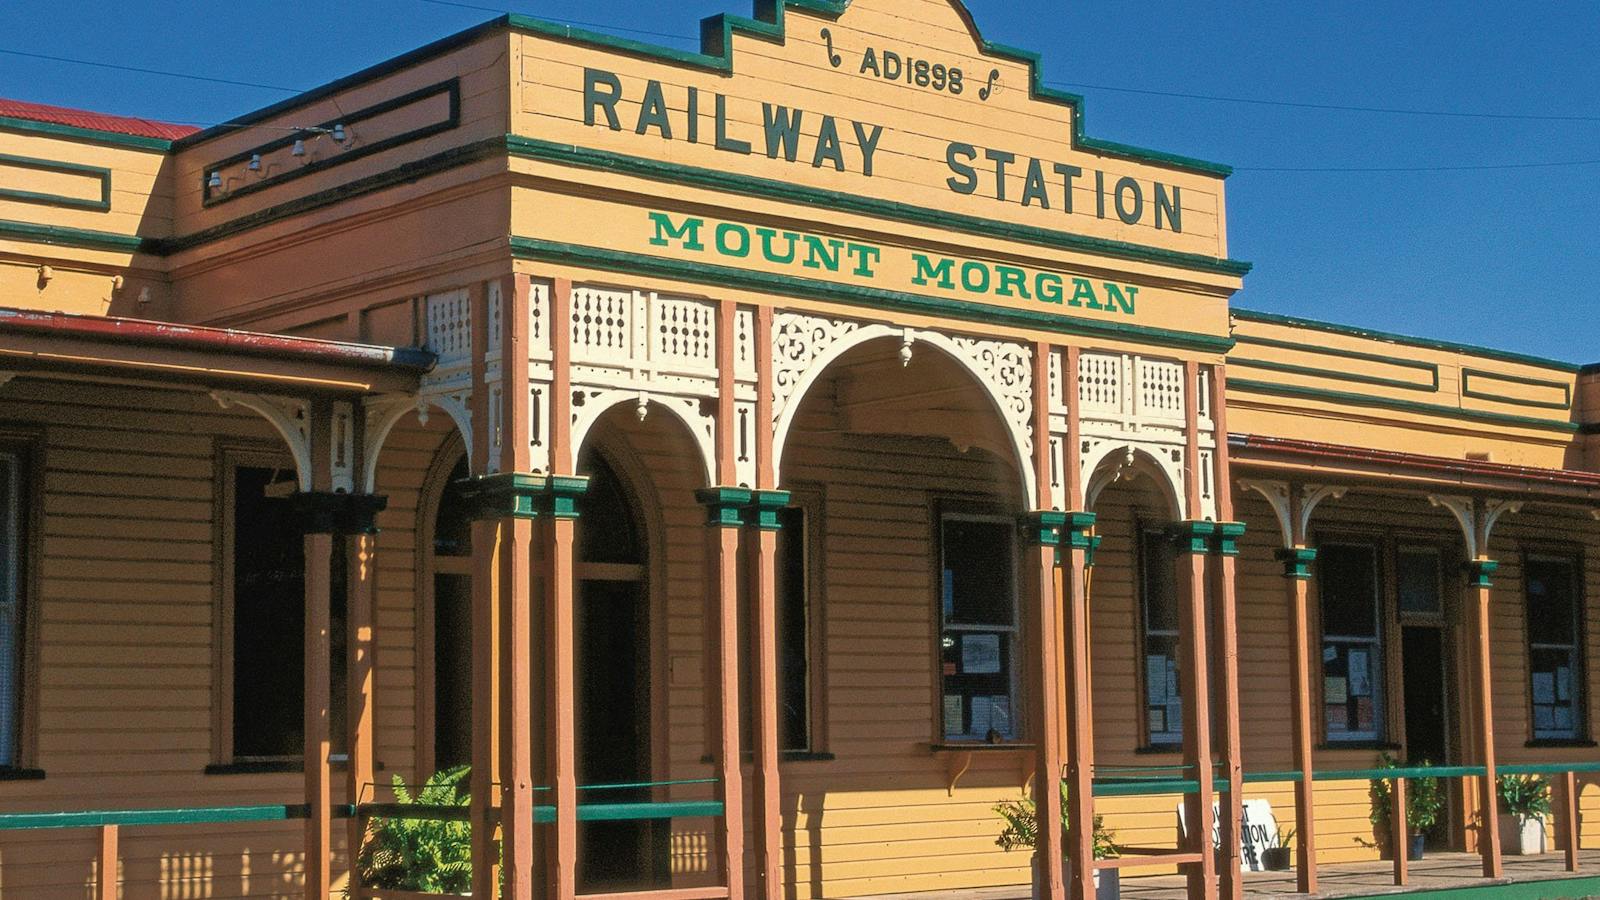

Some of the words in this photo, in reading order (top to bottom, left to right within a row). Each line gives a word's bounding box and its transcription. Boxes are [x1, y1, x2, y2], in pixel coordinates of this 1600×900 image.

[584, 67, 881, 176] RAILWAY
[946, 142, 1182, 233] STATION
[649, 210, 880, 278] MOUNT
[911, 254, 1139, 316] MORGAN
